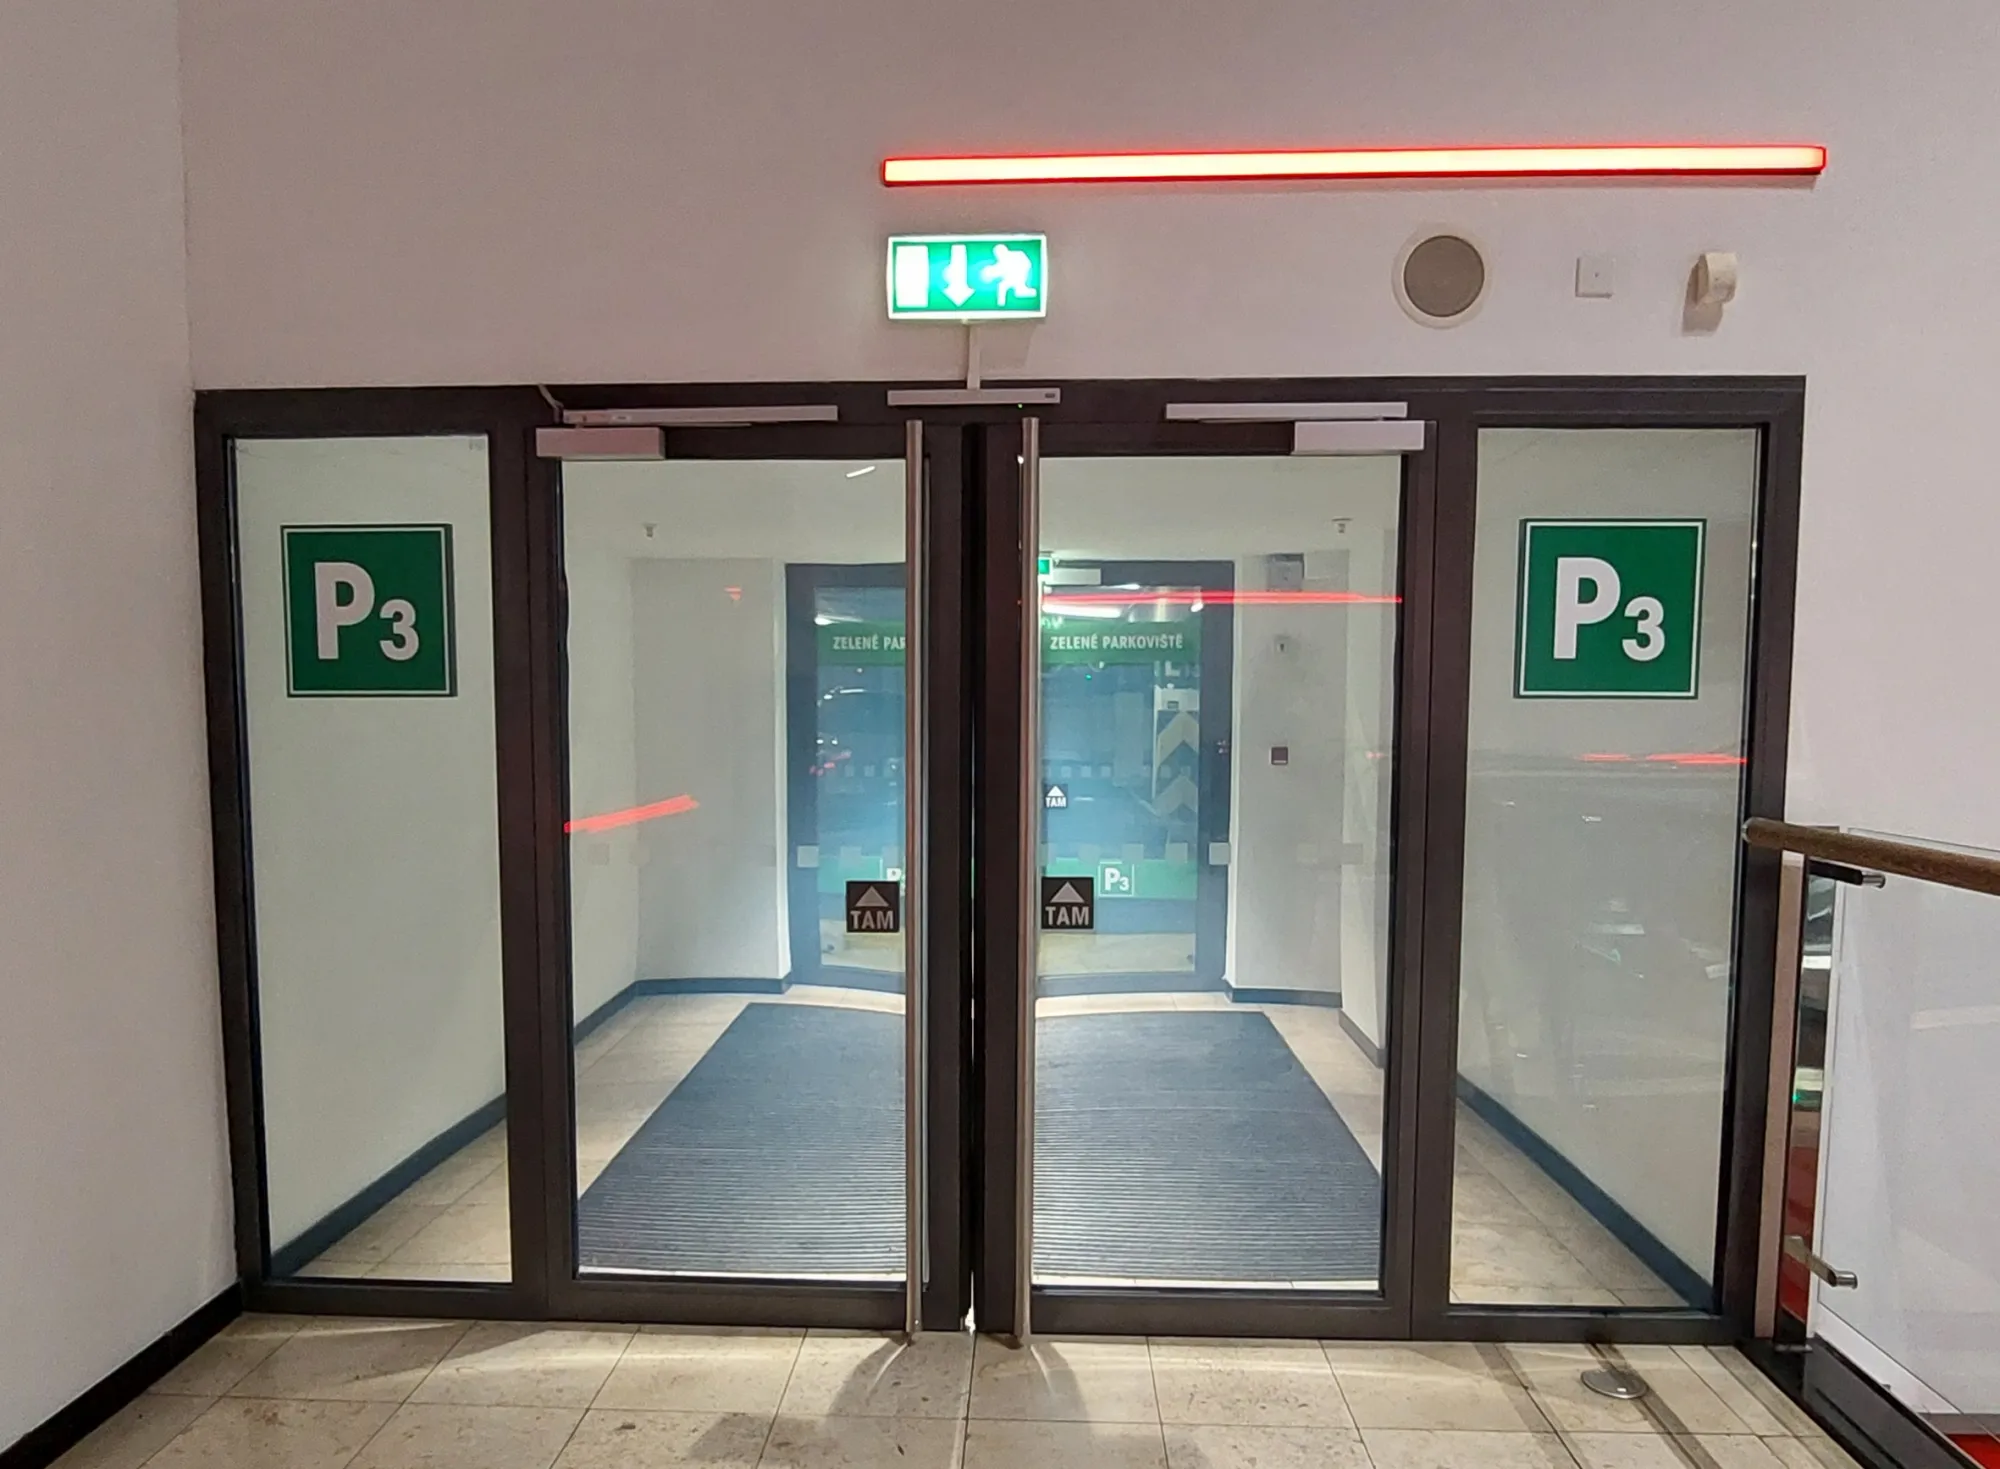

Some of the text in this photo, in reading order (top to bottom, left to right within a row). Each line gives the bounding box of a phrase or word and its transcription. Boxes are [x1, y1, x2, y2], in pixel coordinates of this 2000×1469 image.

[314, 561, 420, 661] P3
[1553, 556, 1666, 662] P3
[832, 633, 879, 650] ZELENÉ
[1050, 633, 1184, 650] ZELENÉ PARKOVIŠTĚ
[1045, 796, 1067, 808] TAM
[1104, 867, 1130, 892] P3
[849, 910, 894, 930] TAM
[1045, 906, 1090, 926] TAM
